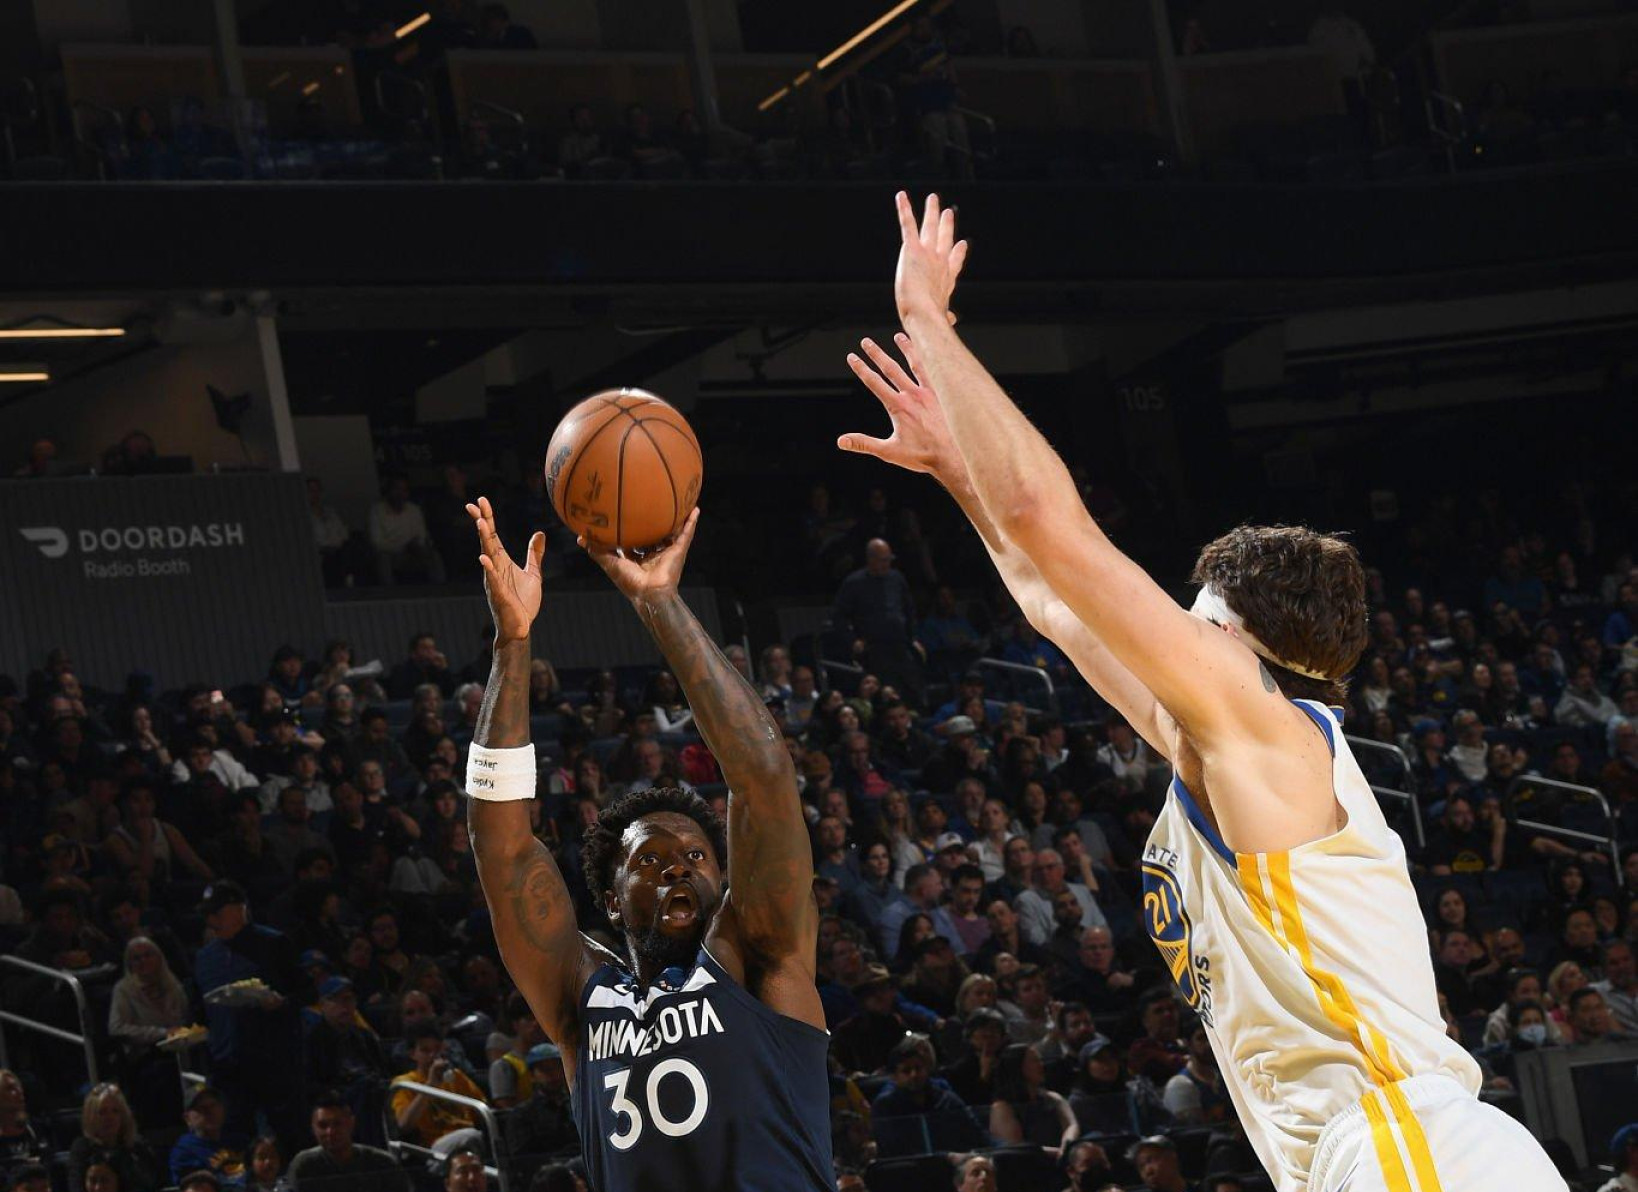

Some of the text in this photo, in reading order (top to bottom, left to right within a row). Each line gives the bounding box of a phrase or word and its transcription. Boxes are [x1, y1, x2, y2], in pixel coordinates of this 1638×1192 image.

[1121, 386, 1165, 411] 105
[79, 523, 244, 552] DOORDASH
[84, 558, 191, 578] Radio Booth
[1144, 884, 1172, 936] 21
[588, 997, 725, 1062] MINNESOTA
[604, 1057, 709, 1150] 30
